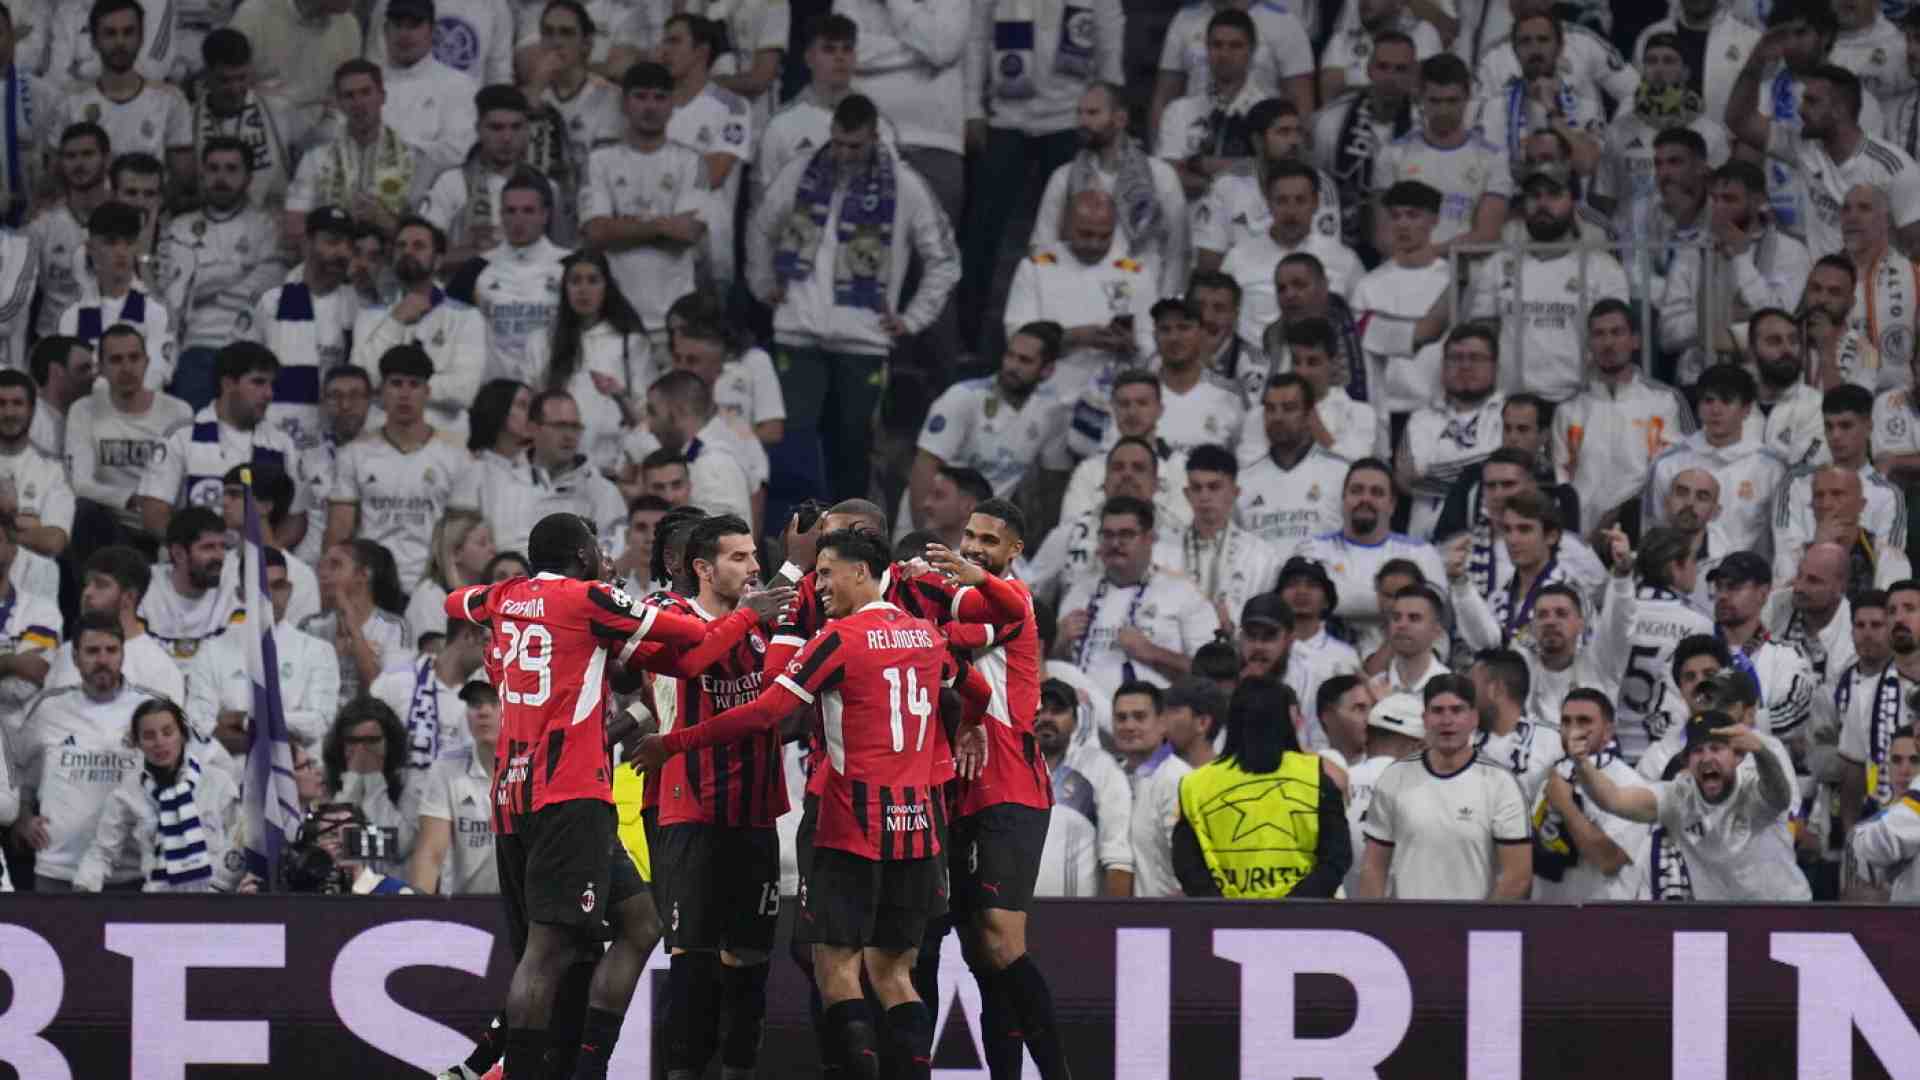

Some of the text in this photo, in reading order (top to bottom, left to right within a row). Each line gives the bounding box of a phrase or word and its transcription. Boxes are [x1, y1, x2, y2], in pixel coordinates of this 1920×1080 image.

[866, 629, 933, 649] REIJNDERS
[500, 621, 552, 704] 29
[701, 671, 764, 693] Emirat
[1622, 644, 1661, 714] 5
[883, 667, 932, 752] 14
[60, 752, 136, 769] Emirates
[886, 814, 929, 831] MILAN
